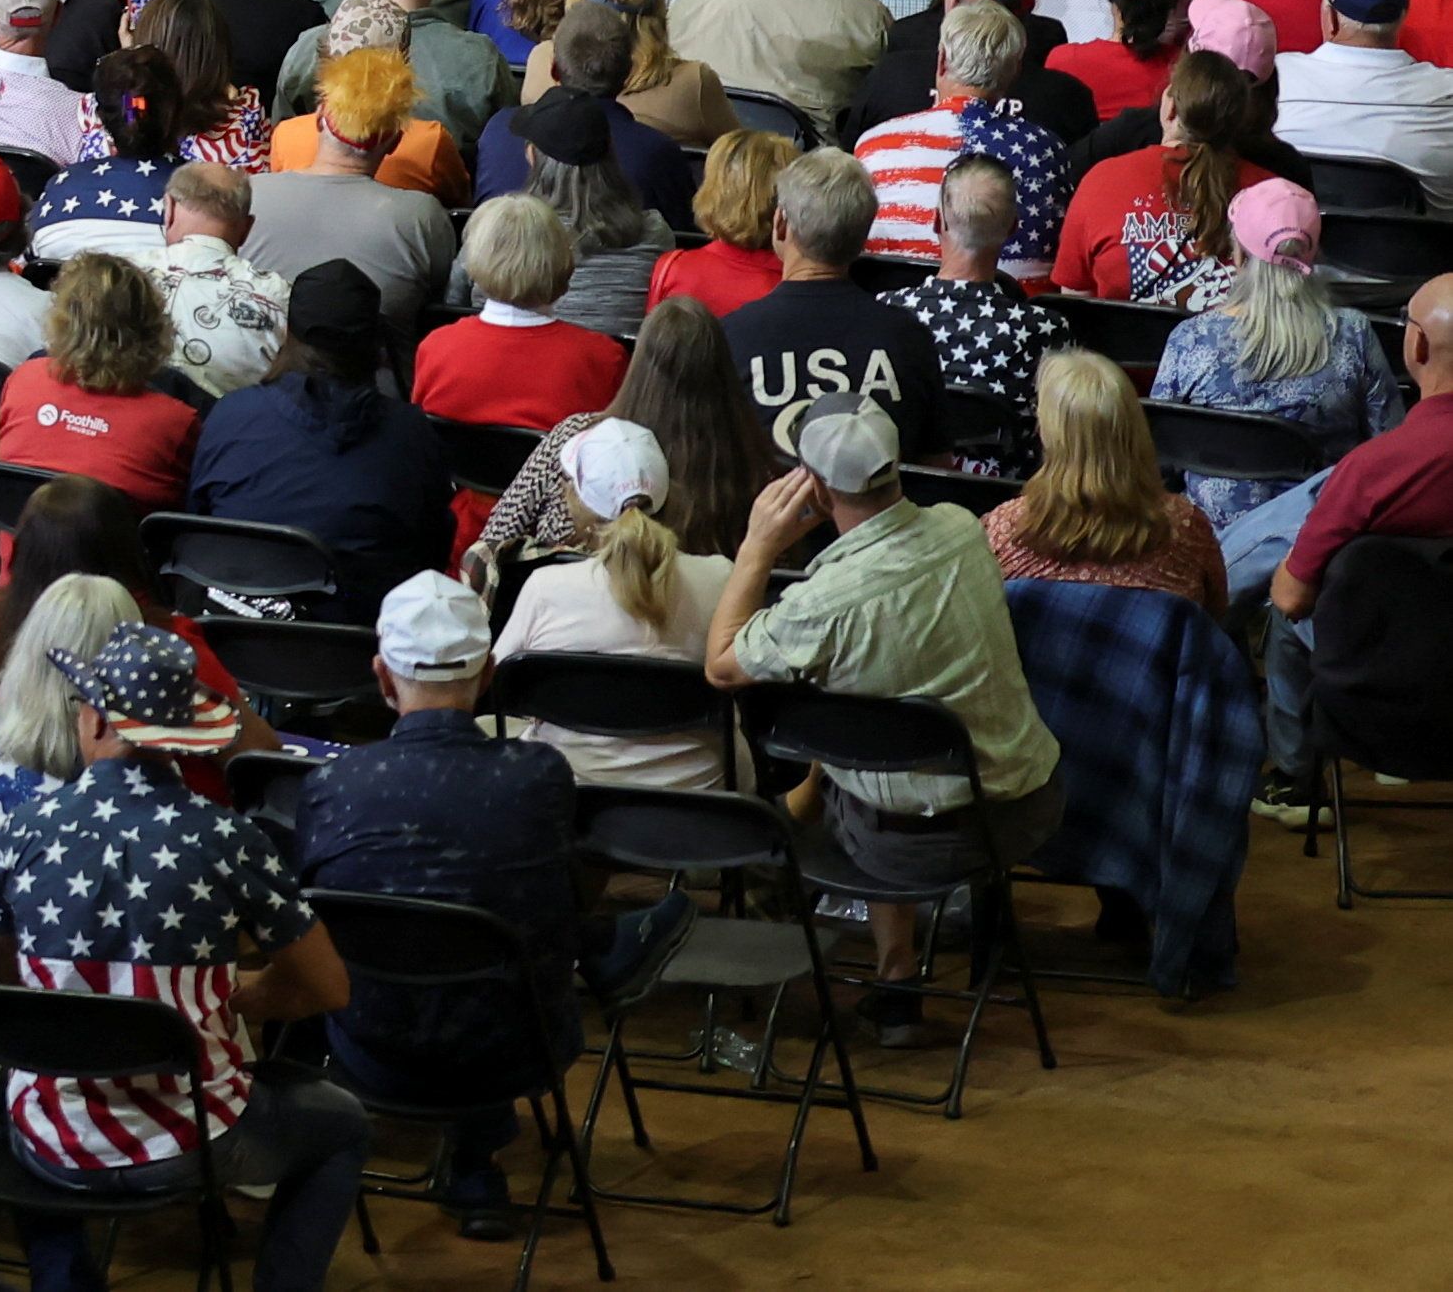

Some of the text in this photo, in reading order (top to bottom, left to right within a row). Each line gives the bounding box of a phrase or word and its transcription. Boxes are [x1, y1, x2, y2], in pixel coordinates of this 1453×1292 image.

[750, 347, 902, 406] USA
[60, 409, 109, 434] Foothills
[66, 423, 97, 437] CHURCH
